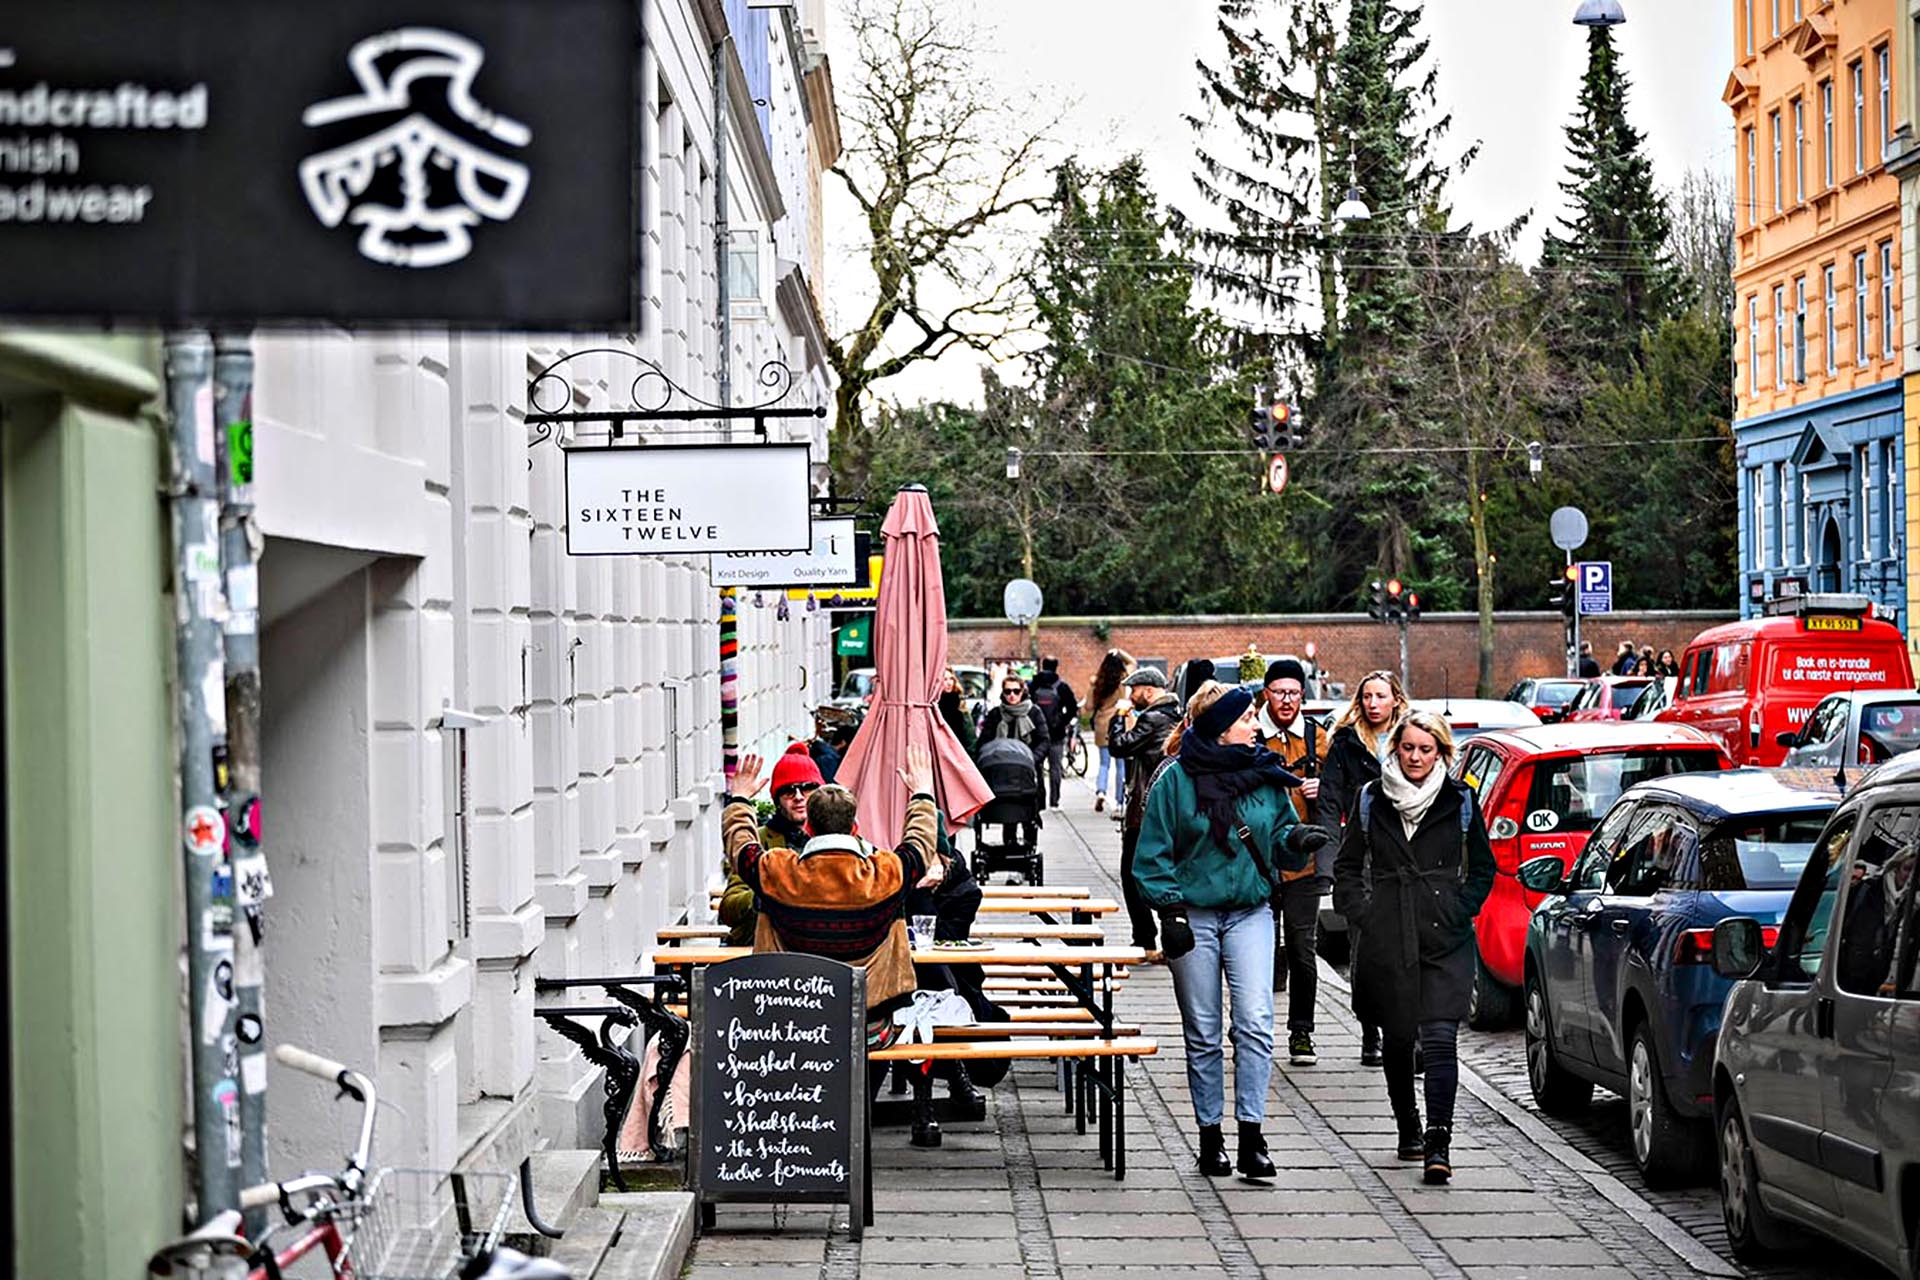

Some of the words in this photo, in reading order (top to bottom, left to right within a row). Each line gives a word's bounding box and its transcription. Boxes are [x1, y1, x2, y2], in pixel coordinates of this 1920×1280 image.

[621, 489, 665, 503] THE
[581, 508, 682, 523] SIXTEEN
[622, 526, 718, 540] TWELVE
[718, 569, 737, 578] Knit
[738, 569, 769, 579] Design
[793, 567, 826, 578] Quality
[827, 567, 848, 576] Yarn
[1586, 566, 1604, 592] P
[1533, 813, 1552, 827] DK
[722, 977, 791, 1000] panna
[794, 975, 835, 997] cotta
[754, 994, 823, 1016] granola
[728, 1017, 783, 1051] french
[784, 1020, 831, 1044] toast
[727, 1139, 753, 1157] the
